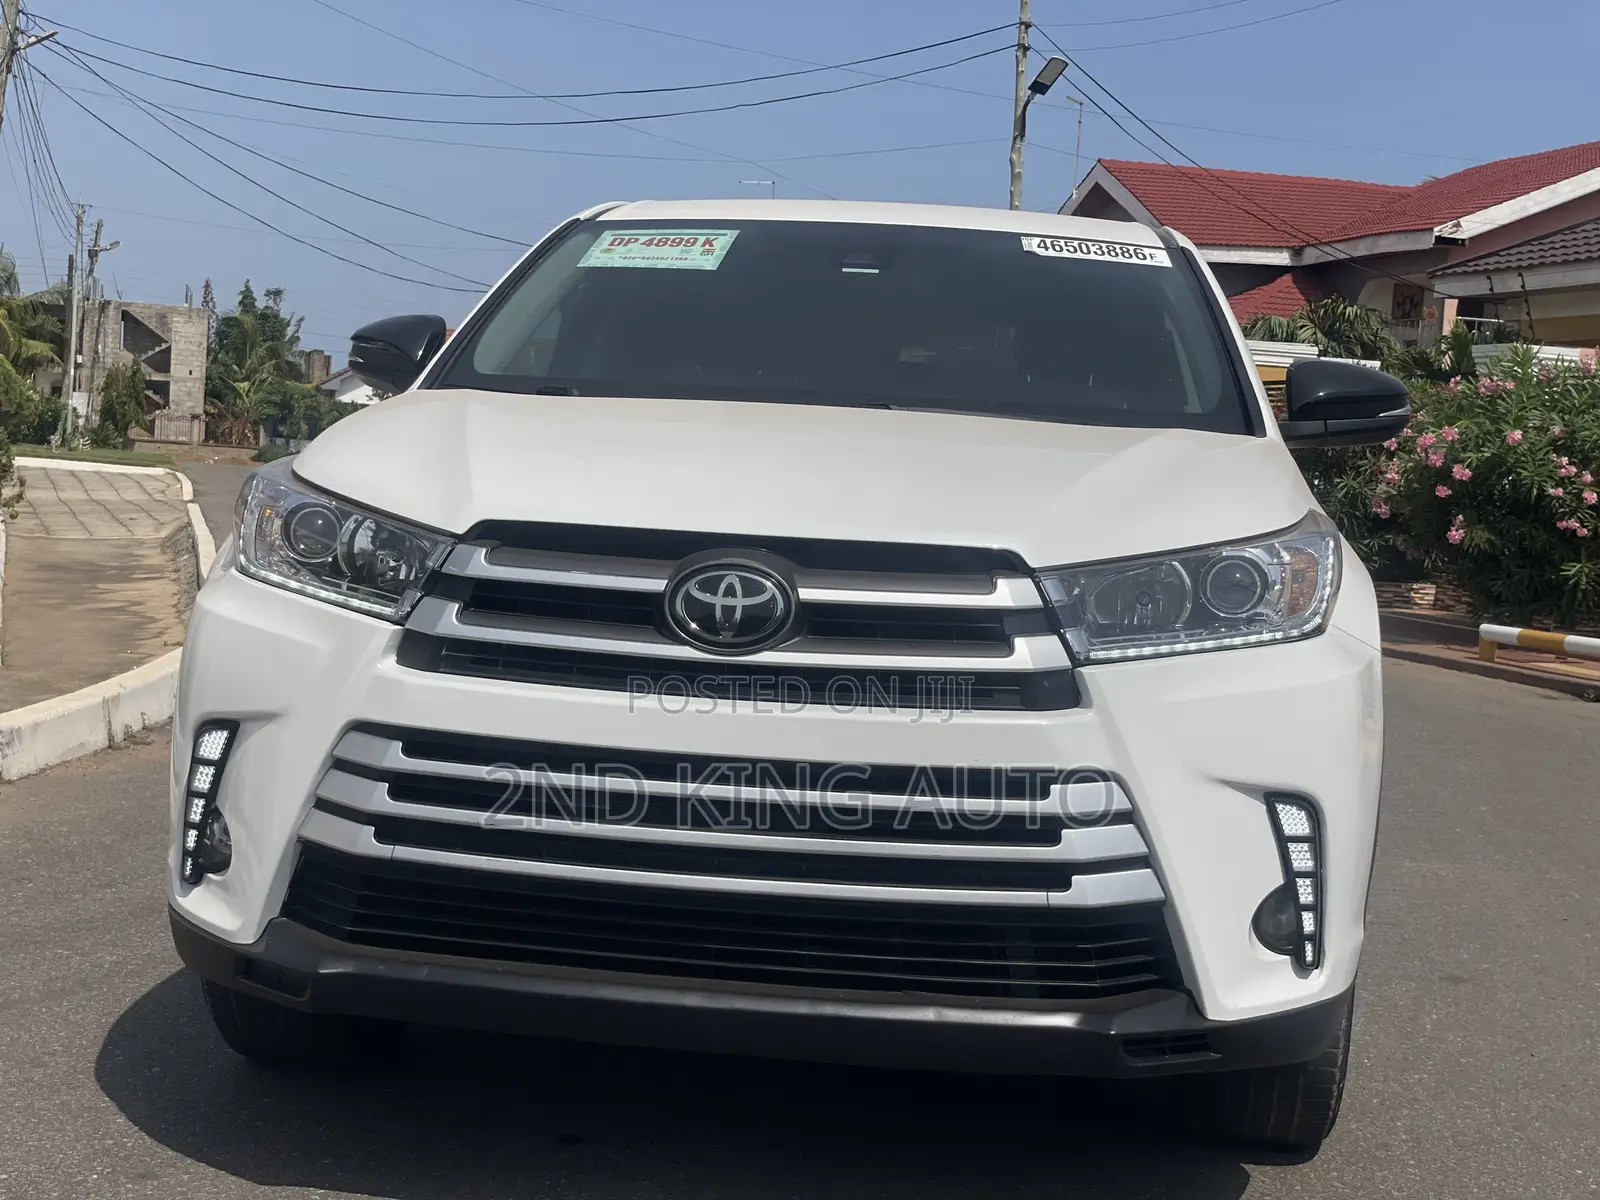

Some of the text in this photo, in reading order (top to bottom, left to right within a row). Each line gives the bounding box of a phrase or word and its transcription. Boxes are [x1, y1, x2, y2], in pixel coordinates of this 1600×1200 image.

[607, 237, 720, 248] DP 4899 K
[1036, 239, 1158, 261] 46503886 F
